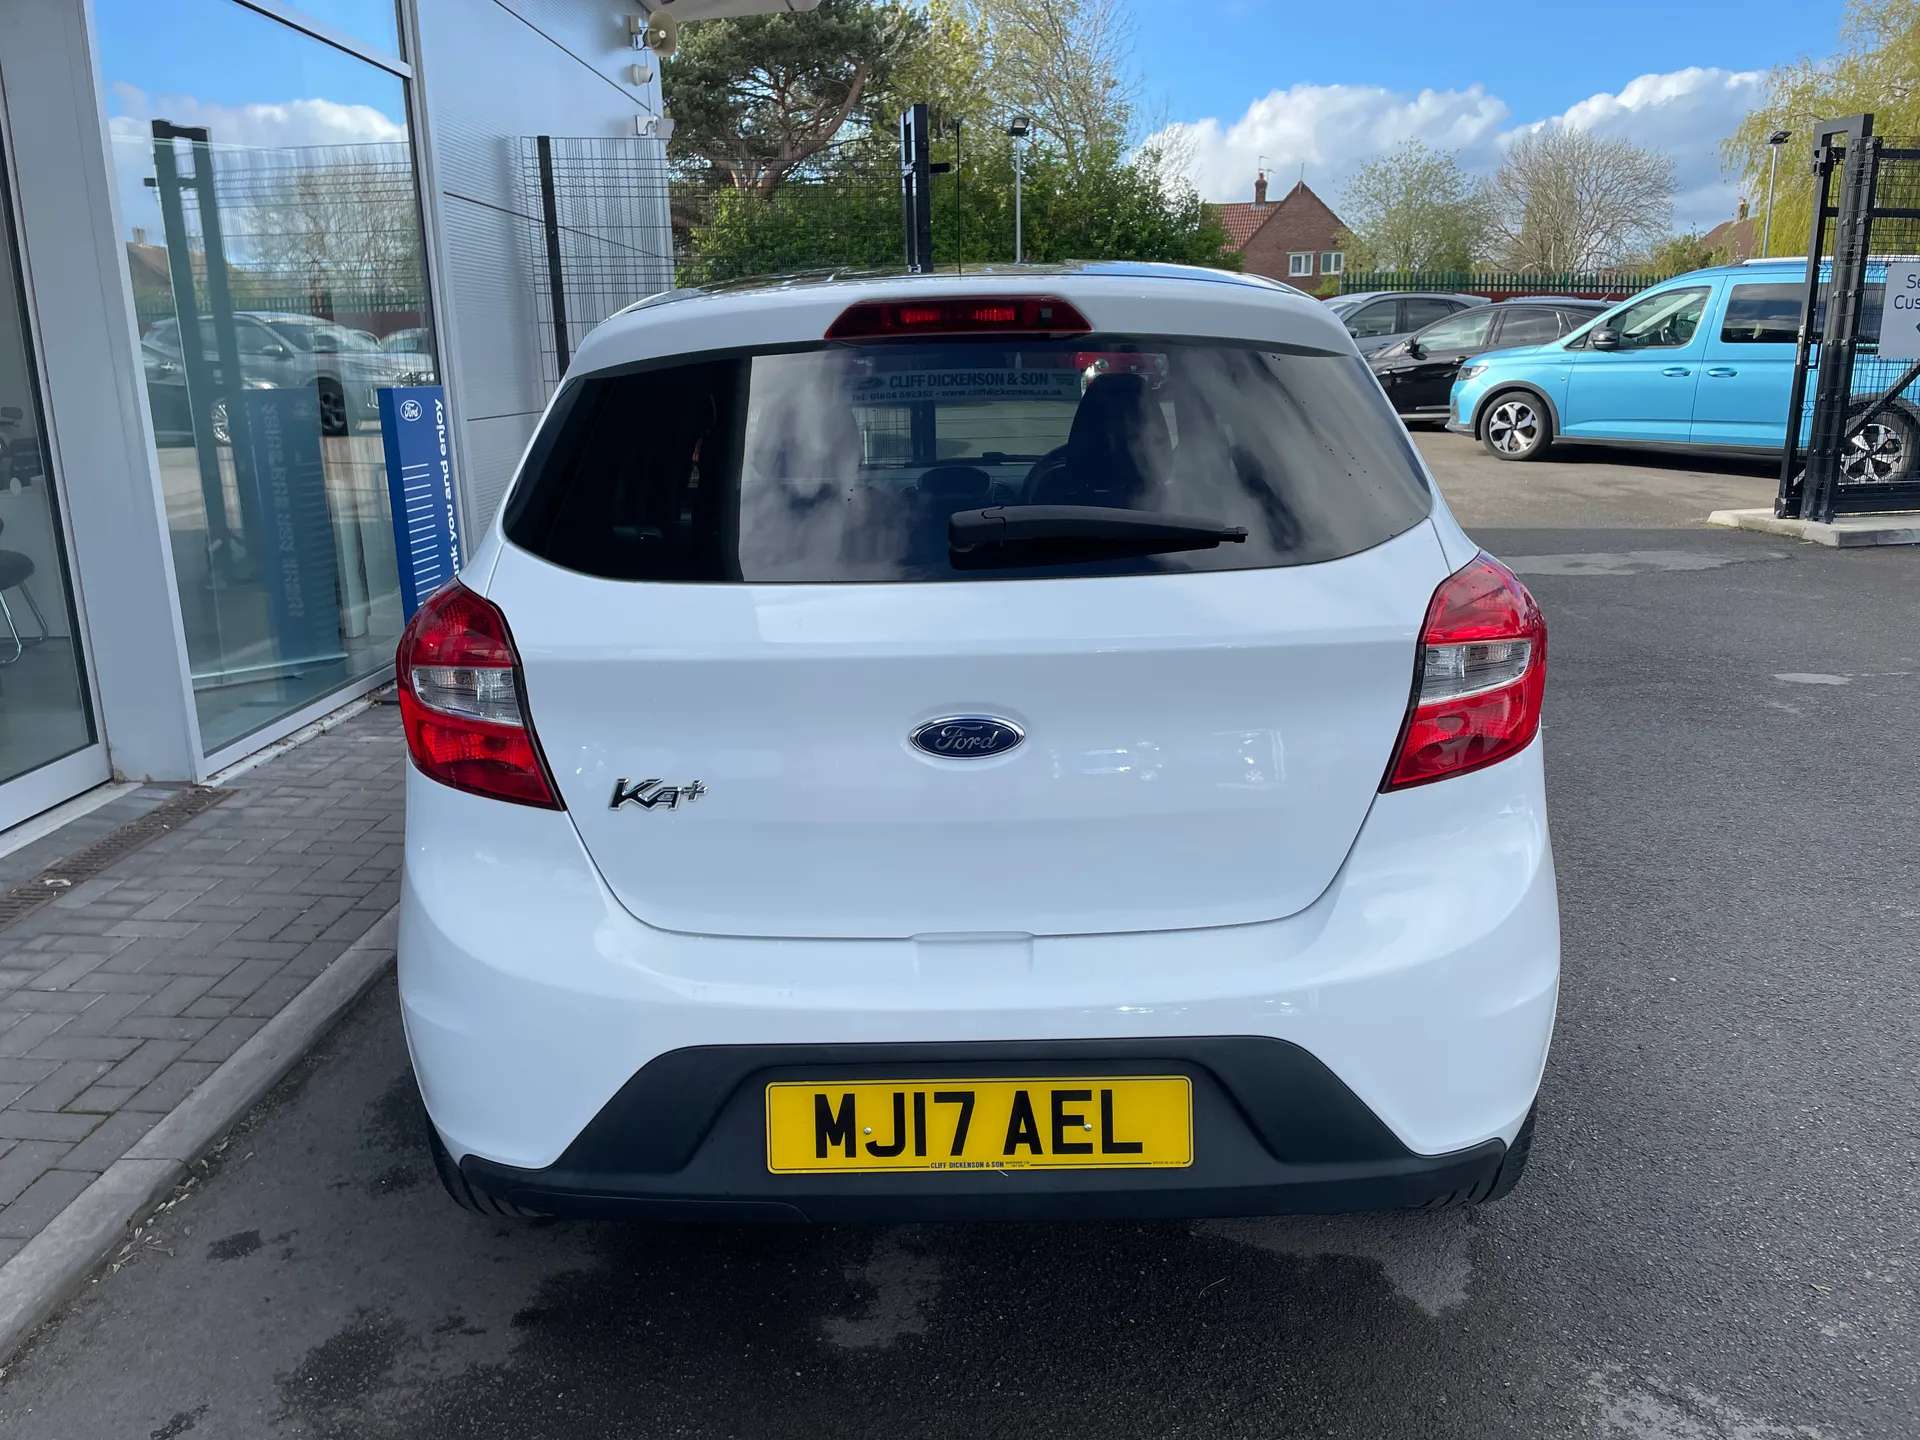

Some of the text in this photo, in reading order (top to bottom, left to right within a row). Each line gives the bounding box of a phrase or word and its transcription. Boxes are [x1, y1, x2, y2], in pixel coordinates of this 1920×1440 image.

[890, 375, 926, 388] CLIFF
[928, 373, 1004, 387] DICKENSON
[1007, 372, 1018, 385] &
[1021, 371, 1048, 385] SON
[434, 398, 447, 456] enjoy
[440, 460, 452, 500] and
[446, 504, 458, 541] you
[934, 725, 998, 751] Ford
[813, 1089, 1143, 1159] MJ17 AEL
[930, 1161, 946, 1169] CLIFF
[949, 1161, 985, 1169] DICKENSON
